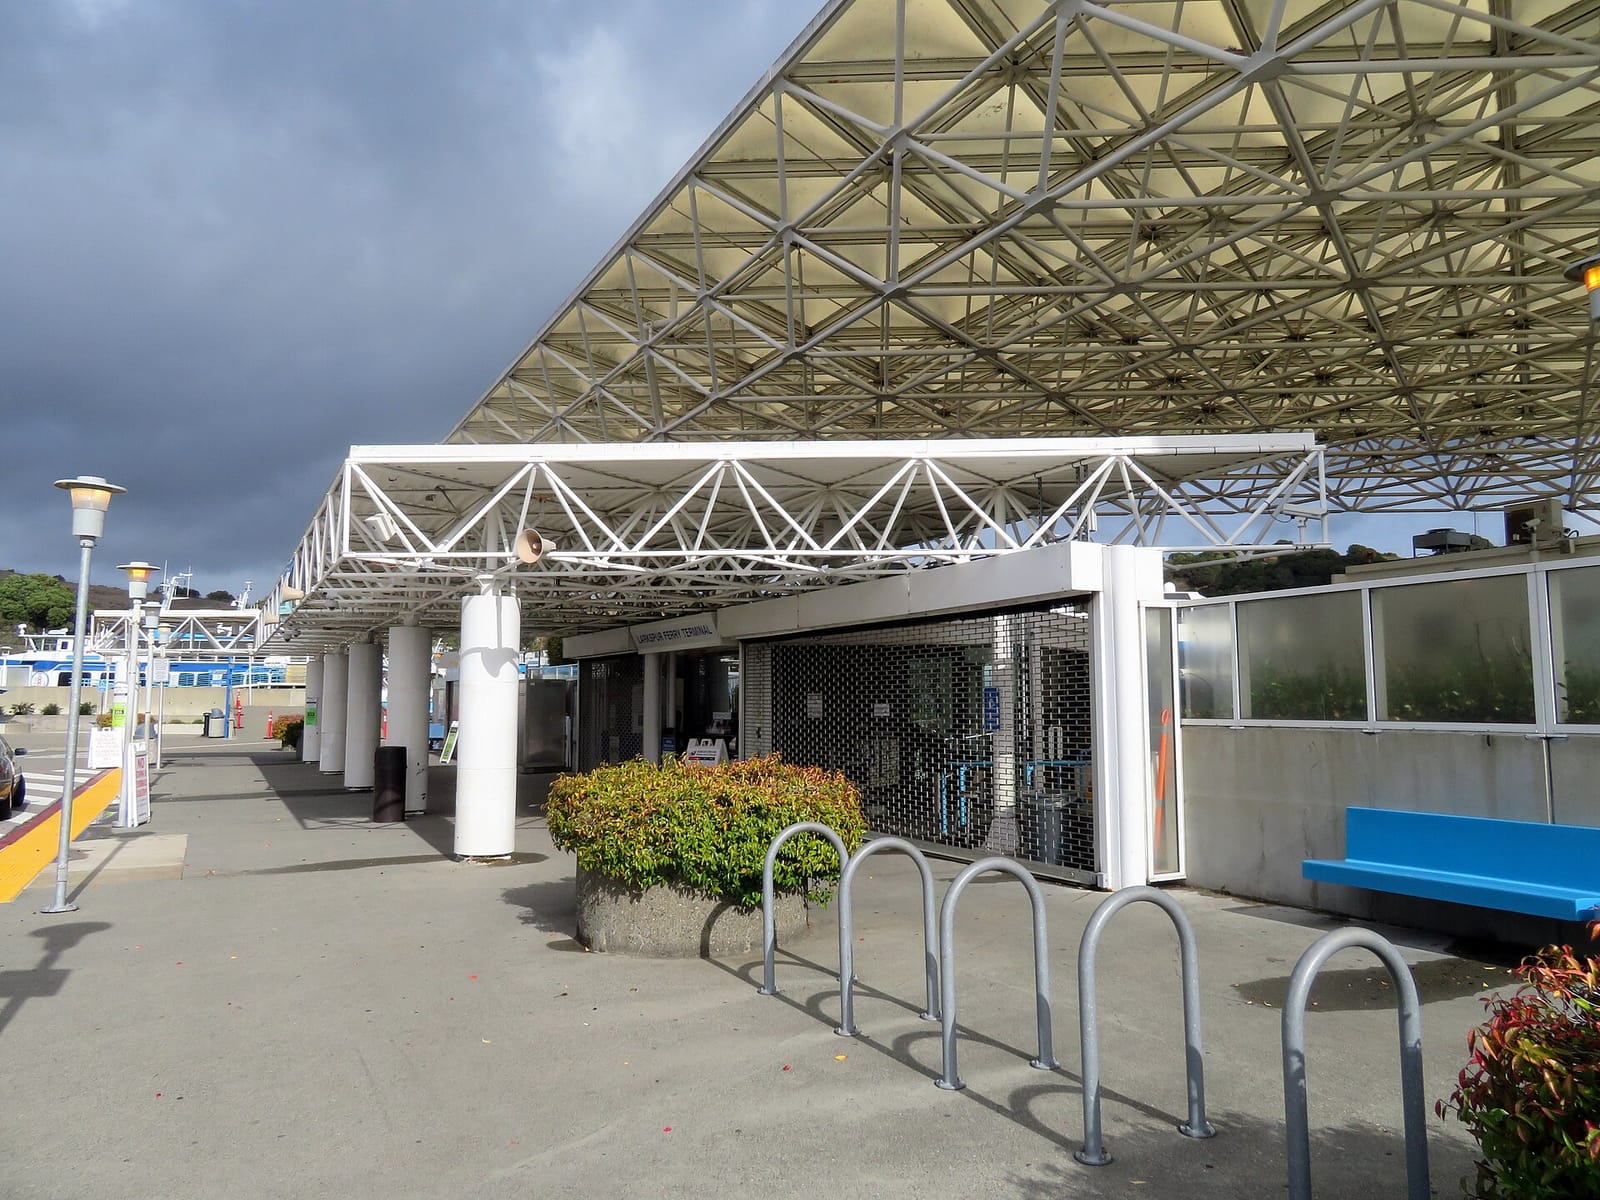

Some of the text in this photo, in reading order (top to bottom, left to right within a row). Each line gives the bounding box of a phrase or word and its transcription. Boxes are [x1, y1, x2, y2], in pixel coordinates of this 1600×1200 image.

[638, 624, 713, 644] LARKSPUR FERRY TERMINAL
